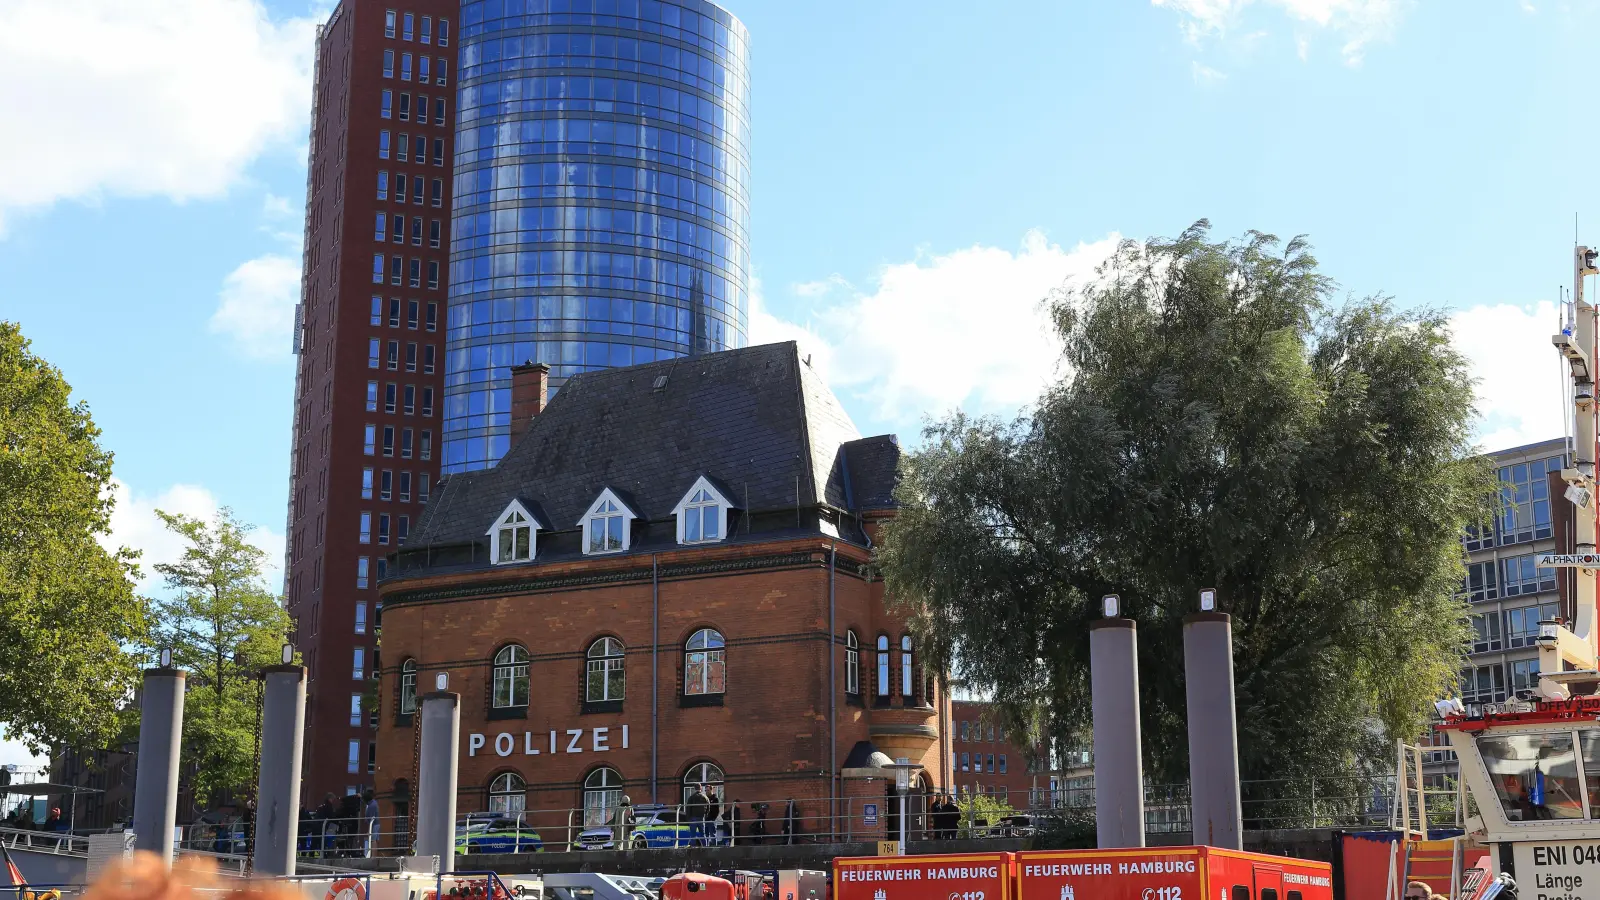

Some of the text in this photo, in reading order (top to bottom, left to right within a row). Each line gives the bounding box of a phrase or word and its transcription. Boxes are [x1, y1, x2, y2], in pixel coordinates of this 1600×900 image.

[1541, 555, 1600, 564] ALPHATRON
[469, 724, 629, 757] POLIZEI
[883, 844, 894, 853] 764
[1533, 846, 1567, 866] ENI
[841, 866, 998, 882] FEUERWEHR HAMBURG
[1025, 860, 1196, 877] FEUERWEHR HAMBURG
[1284, 873, 1330, 887] FEUERWEHR HAMBURG
[1535, 873, 1583, 892] Länge
[962, 891, 985, 900] 112
[1157, 886, 1182, 900] 112
